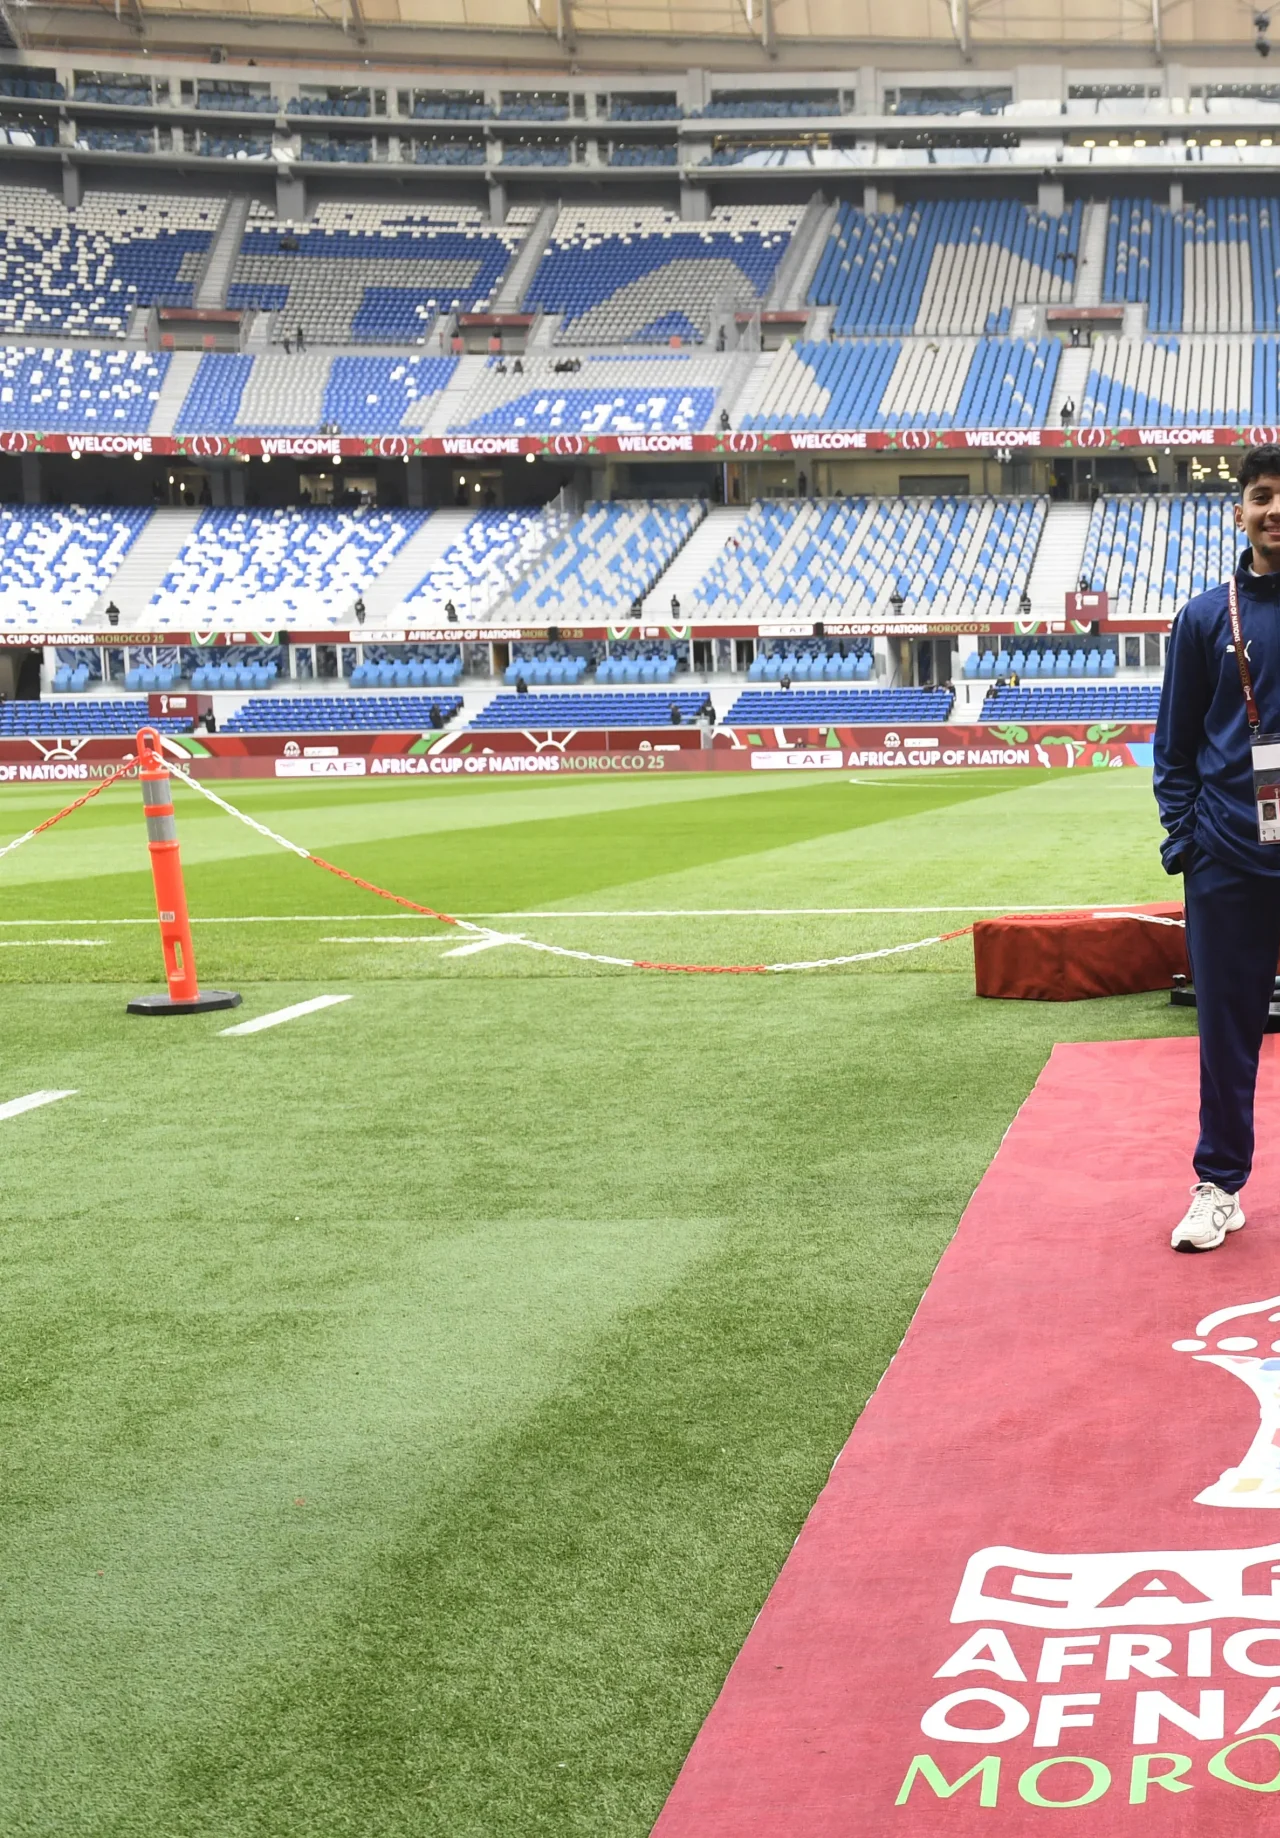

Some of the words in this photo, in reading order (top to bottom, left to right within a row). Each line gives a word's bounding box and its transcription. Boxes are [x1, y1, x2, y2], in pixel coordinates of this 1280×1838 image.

[67, 436, 152, 453] WELCOME
[617, 435, 693, 451] WELCOME
[790, 433, 867, 449] WELCOME
[965, 431, 1041, 446] WELCOME
[1138, 429, 1215, 445] WELCOME
[261, 437, 341, 454] WELCOME
[442, 438, 519, 454] WELCOME
[408, 631, 443, 641] AFRICA
[444, 630, 464, 641] CUP
[464, 630, 478, 640] OF
[479, 629, 521, 640] NATIONS
[850, 624, 871, 635] CUP
[871, 624, 885, 634] OF
[886, 624, 928, 634] NATIONS
[928, 623, 977, 633] MOROCCO
[979, 623, 990, 633] 25
[6, 634, 29, 645] CUP
[29, 634, 46, 645] OF
[47, 634, 95, 645] NATIONS
[95, 634, 150, 643] MOROCCO
[153, 634, 164, 643] 25
[310, 762, 354, 773] CAF
[370, 758, 429, 775] AFRICA
[429, 757, 464, 773] CUP
[464, 757, 488, 773] OF
[488, 755, 560, 771] NATIONS
[560, 754, 644, 770] MOROCCO
[647, 755, 665, 769] 25
[786, 754, 832, 765] CAF
[847, 751, 905, 767] AFRICA
[908, 750, 942, 766] CUP
[942, 749, 966, 766] OF
[967, 748, 1030, 765] NATION
[0, 765, 17, 780] OF
[19, 764, 88, 779] NATIONS
[919, 1686, 1101, 1748] OF
